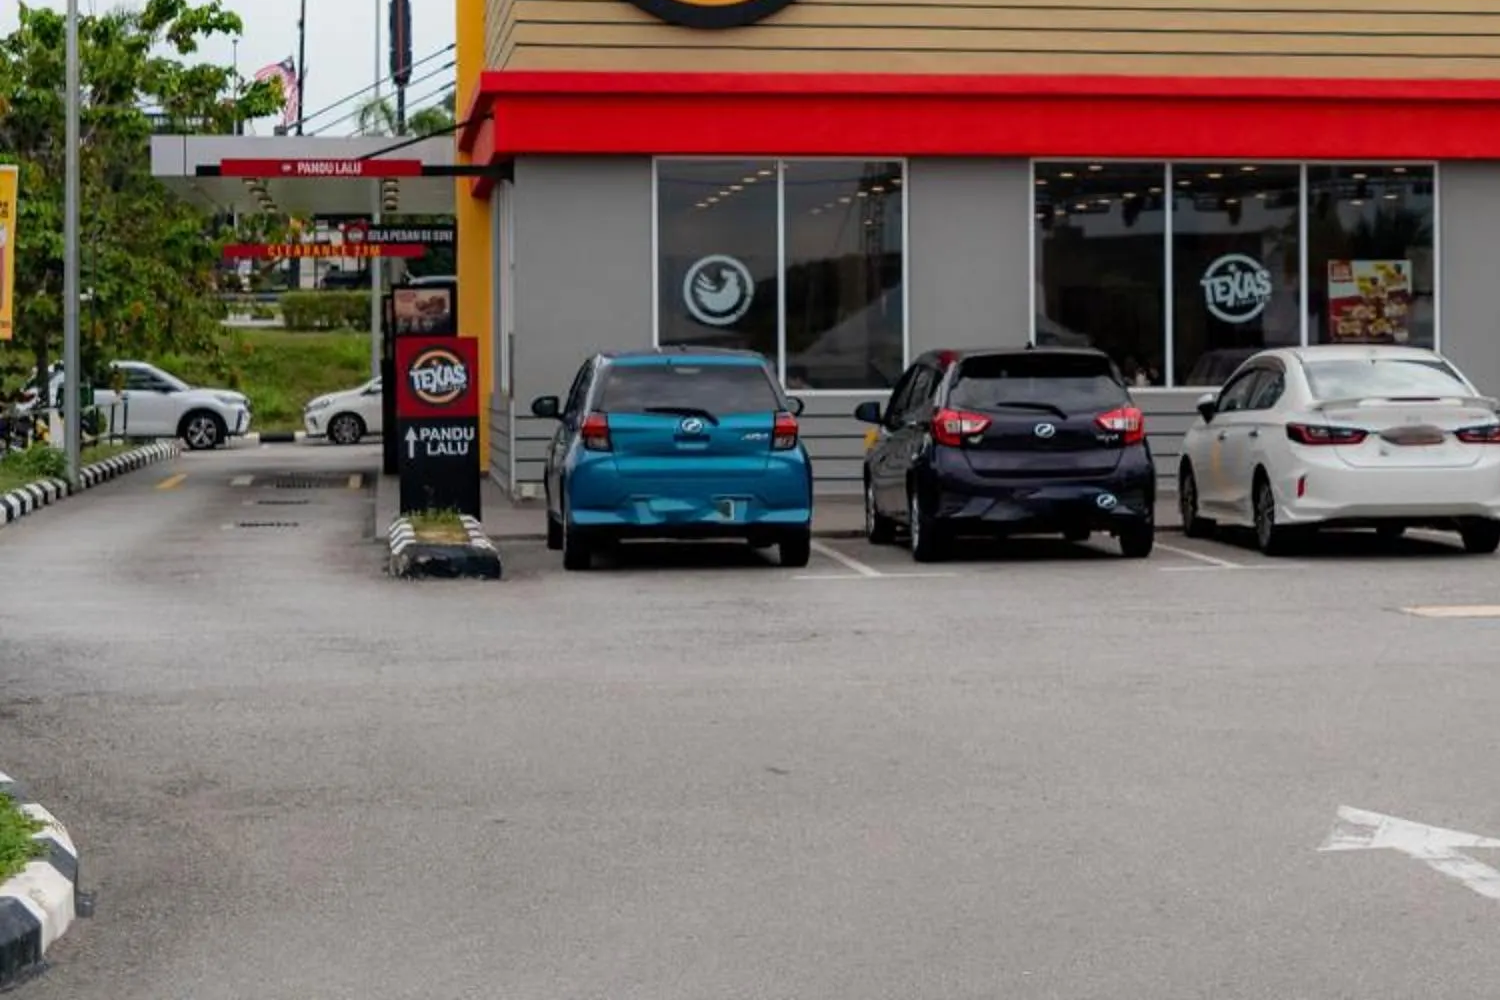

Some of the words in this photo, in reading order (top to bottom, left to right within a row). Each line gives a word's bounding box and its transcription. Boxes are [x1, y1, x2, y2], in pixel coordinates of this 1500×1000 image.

[297, 160, 334, 175] PANDU
[335, 161, 362, 175] LALU
[267, 244, 348, 257] CLEARANCE
[1200, 269, 1272, 308] TEXAS
[409, 364, 467, 393] TEXAS
[420, 427, 475, 440] PANDU
[427, 441, 469, 455] LALU
